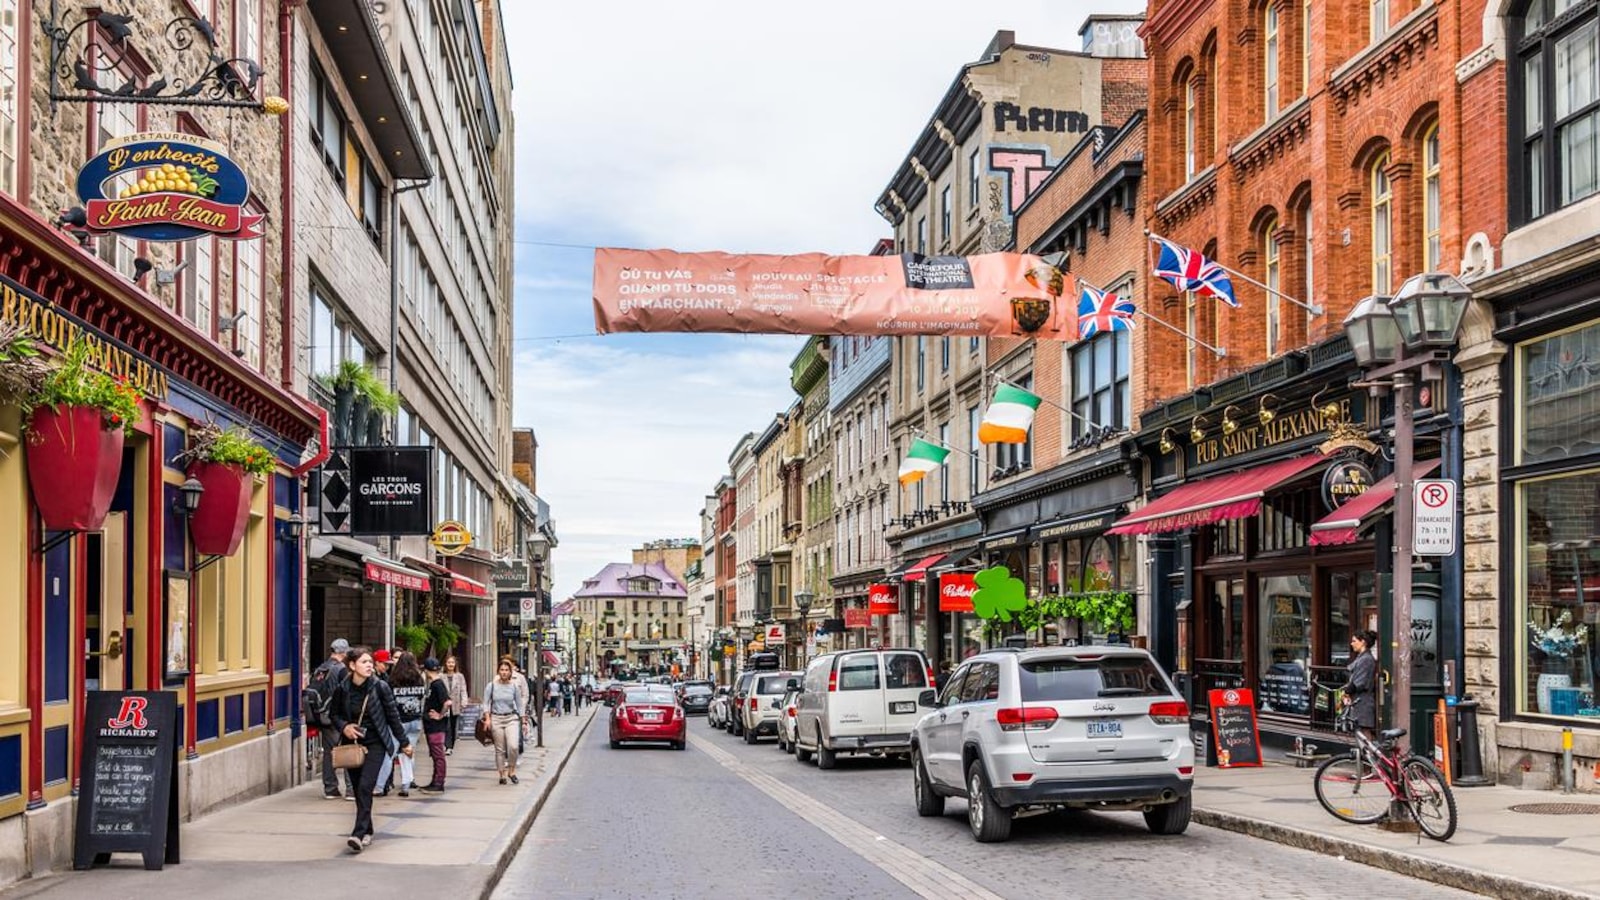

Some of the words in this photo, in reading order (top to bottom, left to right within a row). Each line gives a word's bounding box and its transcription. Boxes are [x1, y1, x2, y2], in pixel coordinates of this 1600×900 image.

[123, 132, 203, 144] RESTAURANT
[907, 261, 965, 271] CARREFOUR
[641, 270, 662, 280] TU
[665, 269, 693, 280] VAS
[752, 273, 812, 281] NOUVEAU
[816, 274, 885, 285] SPECTACLE
[909, 274, 924, 283] DE
[619, 283, 671, 295] QUAND
[674, 283, 691, 294] TU
[695, 283, 737, 295] DORS
[620, 299, 639, 310] EN
[876, 321, 918, 329] NOURRIR
[920, 321, 981, 330] L'IMAGINAIRE
[1196, 440, 1218, 464] PUB
[1331, 483, 1370, 495] GUINNE
[100, 729, 157, 737] RICKARD'S
